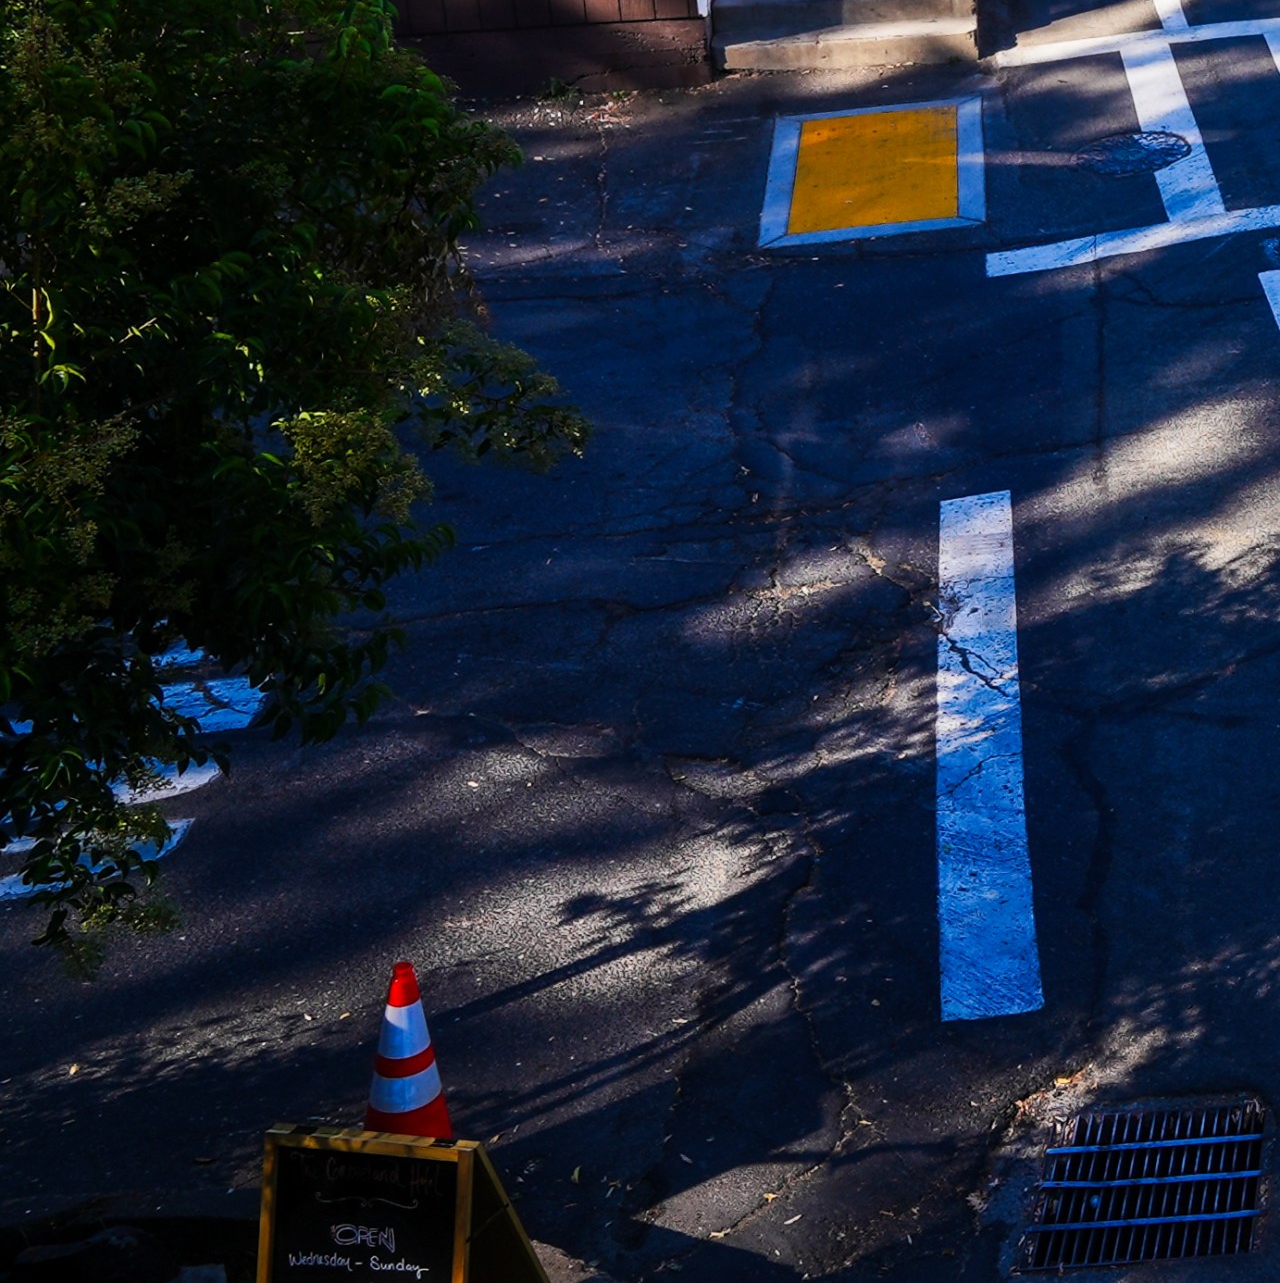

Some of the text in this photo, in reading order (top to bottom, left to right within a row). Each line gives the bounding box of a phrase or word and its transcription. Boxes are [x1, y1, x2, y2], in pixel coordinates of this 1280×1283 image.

[333, 1223, 396, 1254] OPEN
[288, 1251, 353, 1272] Wednesday
[369, 1255, 430, 1280] Sunday
